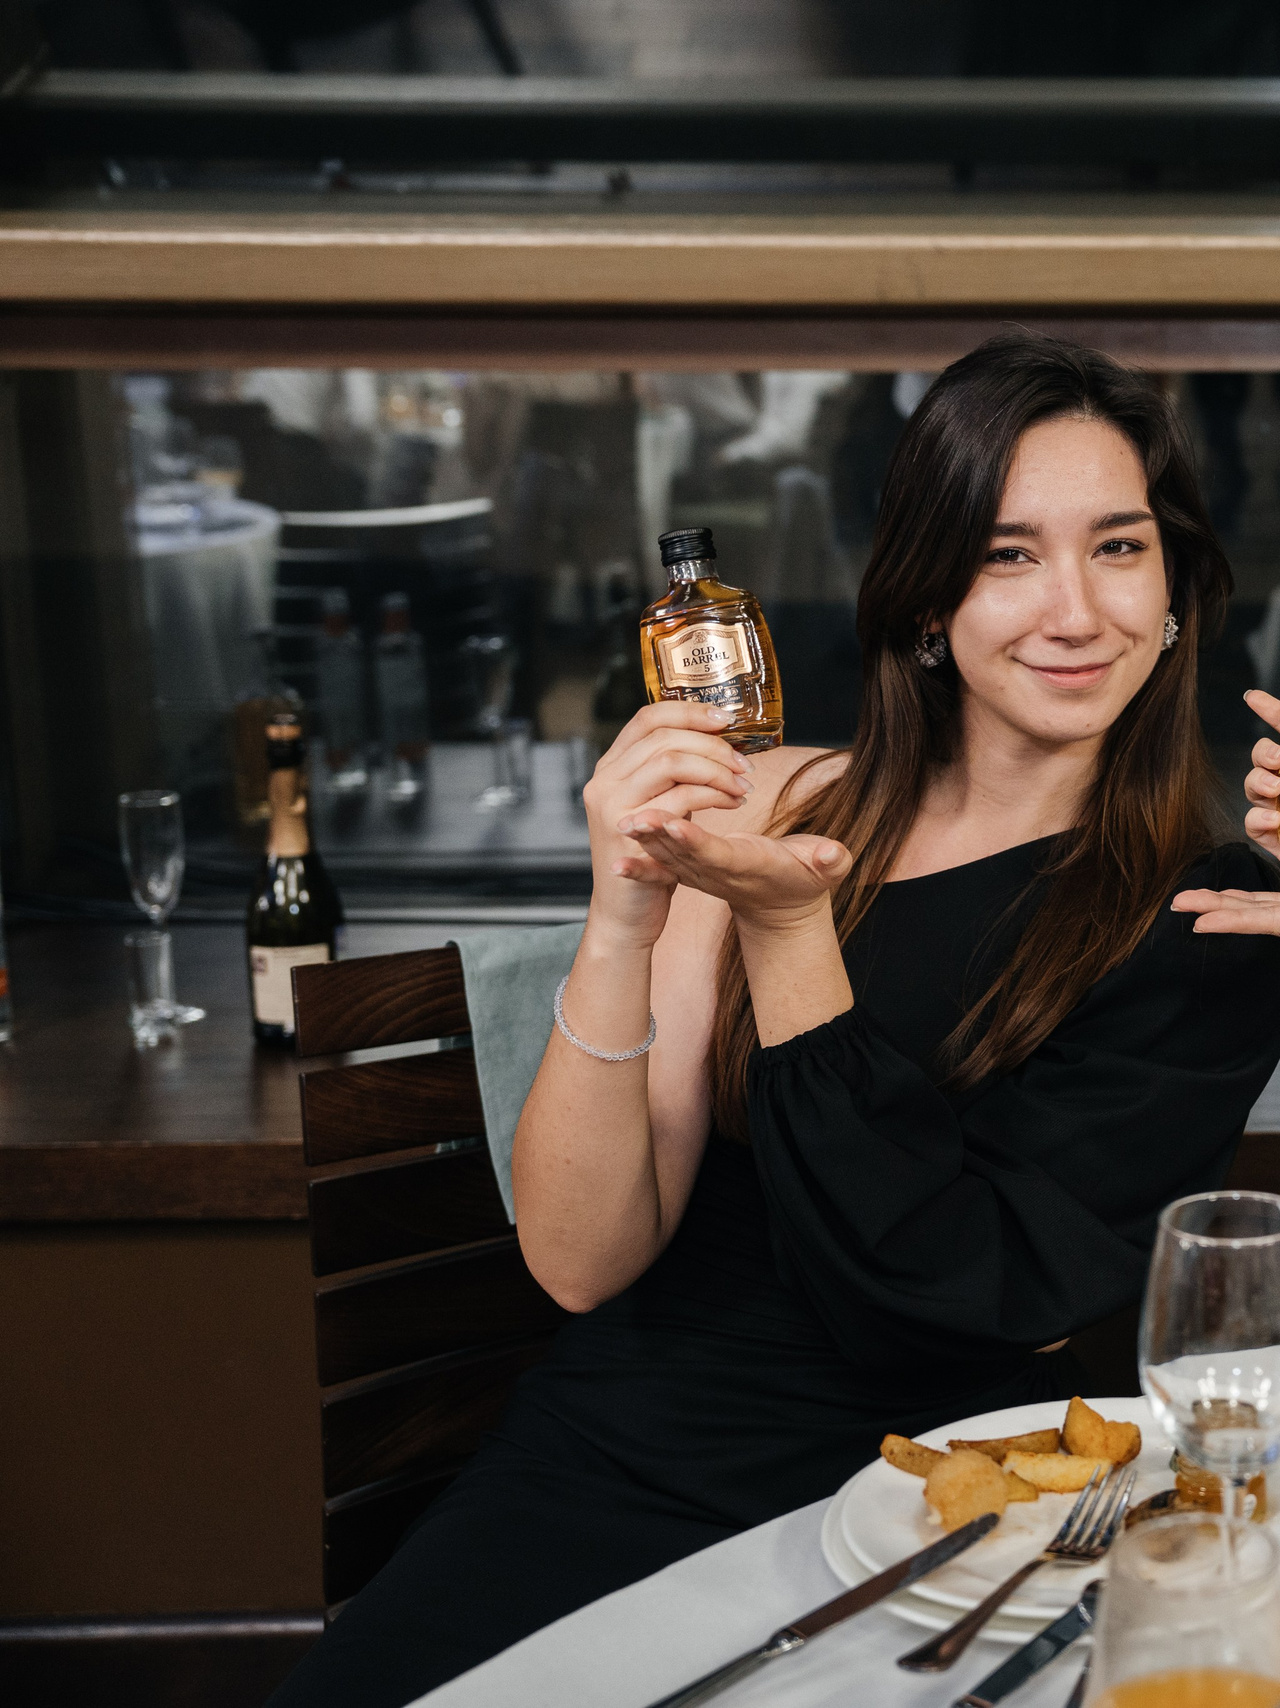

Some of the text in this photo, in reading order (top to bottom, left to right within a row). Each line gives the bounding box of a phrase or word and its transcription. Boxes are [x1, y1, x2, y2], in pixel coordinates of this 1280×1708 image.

[692, 646, 715, 657] OLD
[683, 652, 729, 667] BARREL
[704, 664, 710, 673] 5
